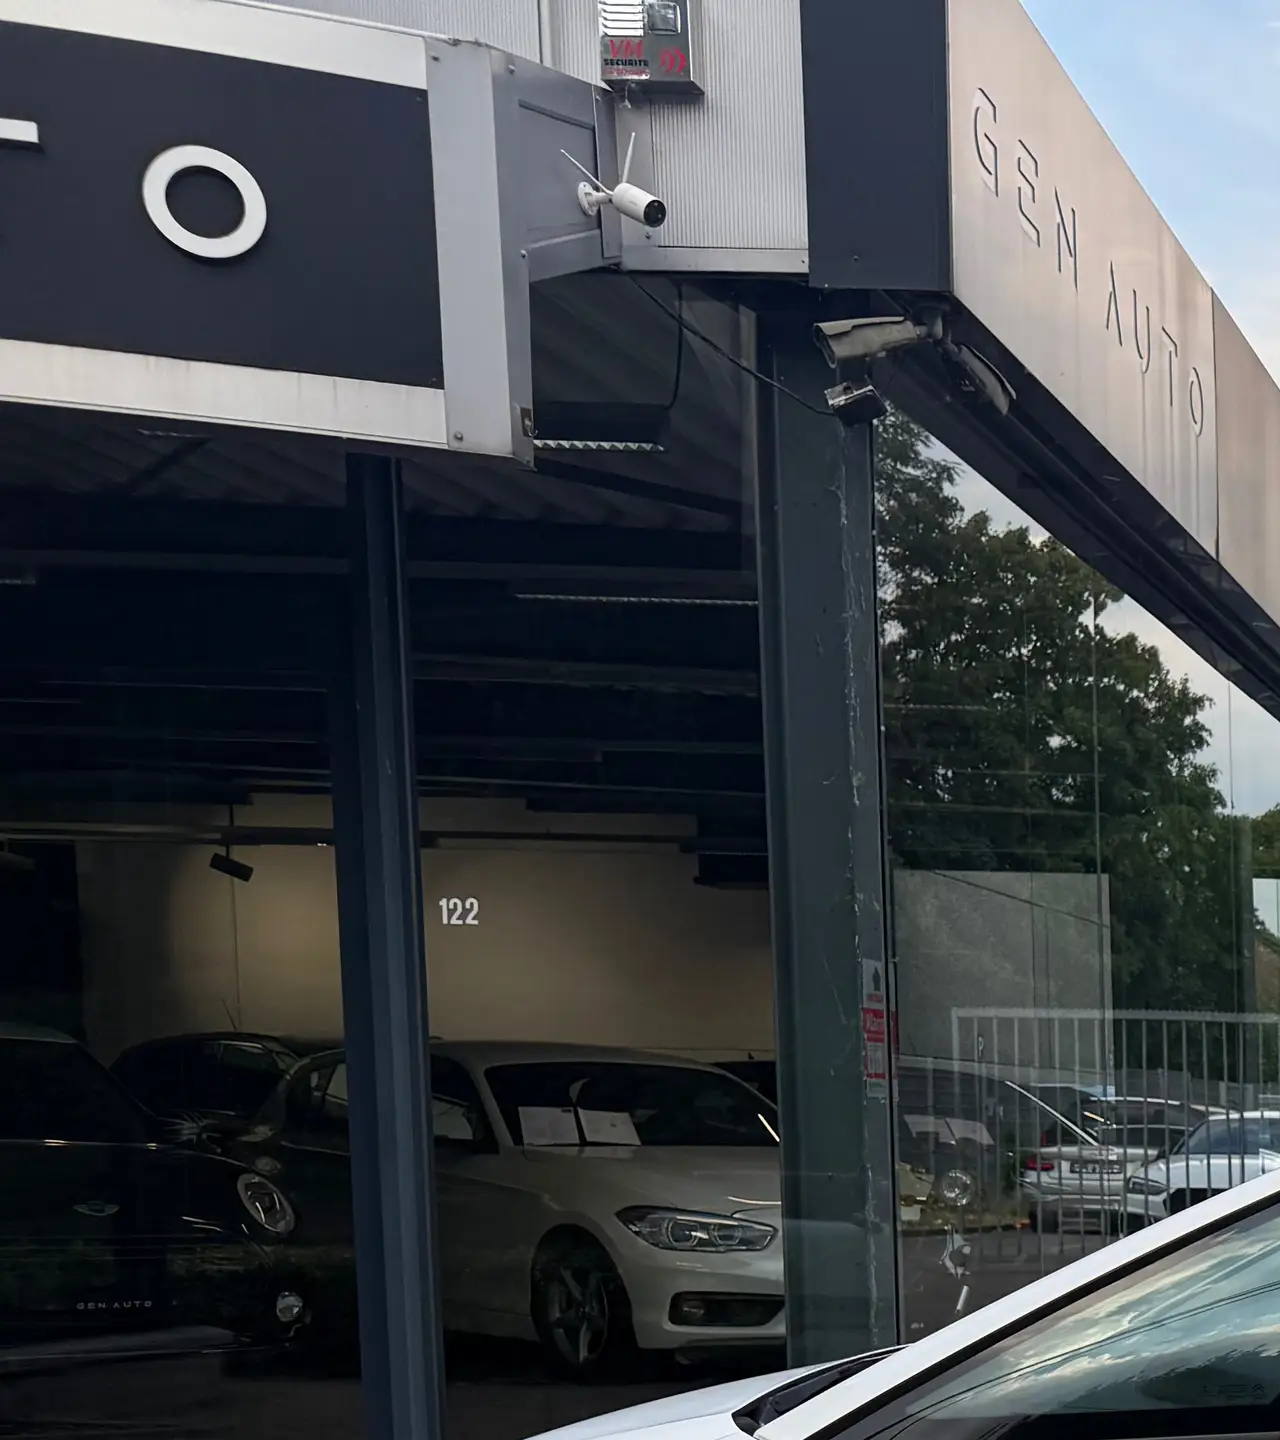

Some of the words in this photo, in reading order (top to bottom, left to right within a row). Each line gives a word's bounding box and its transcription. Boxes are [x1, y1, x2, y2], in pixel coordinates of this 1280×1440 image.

[972, 86, 1079, 292] GEN
[1105, 259, 1206, 437] AUTO
[438, 897, 481, 927] 122
[76, 1301, 107, 1310] GEN
[113, 1299, 153, 1309] AUTO
